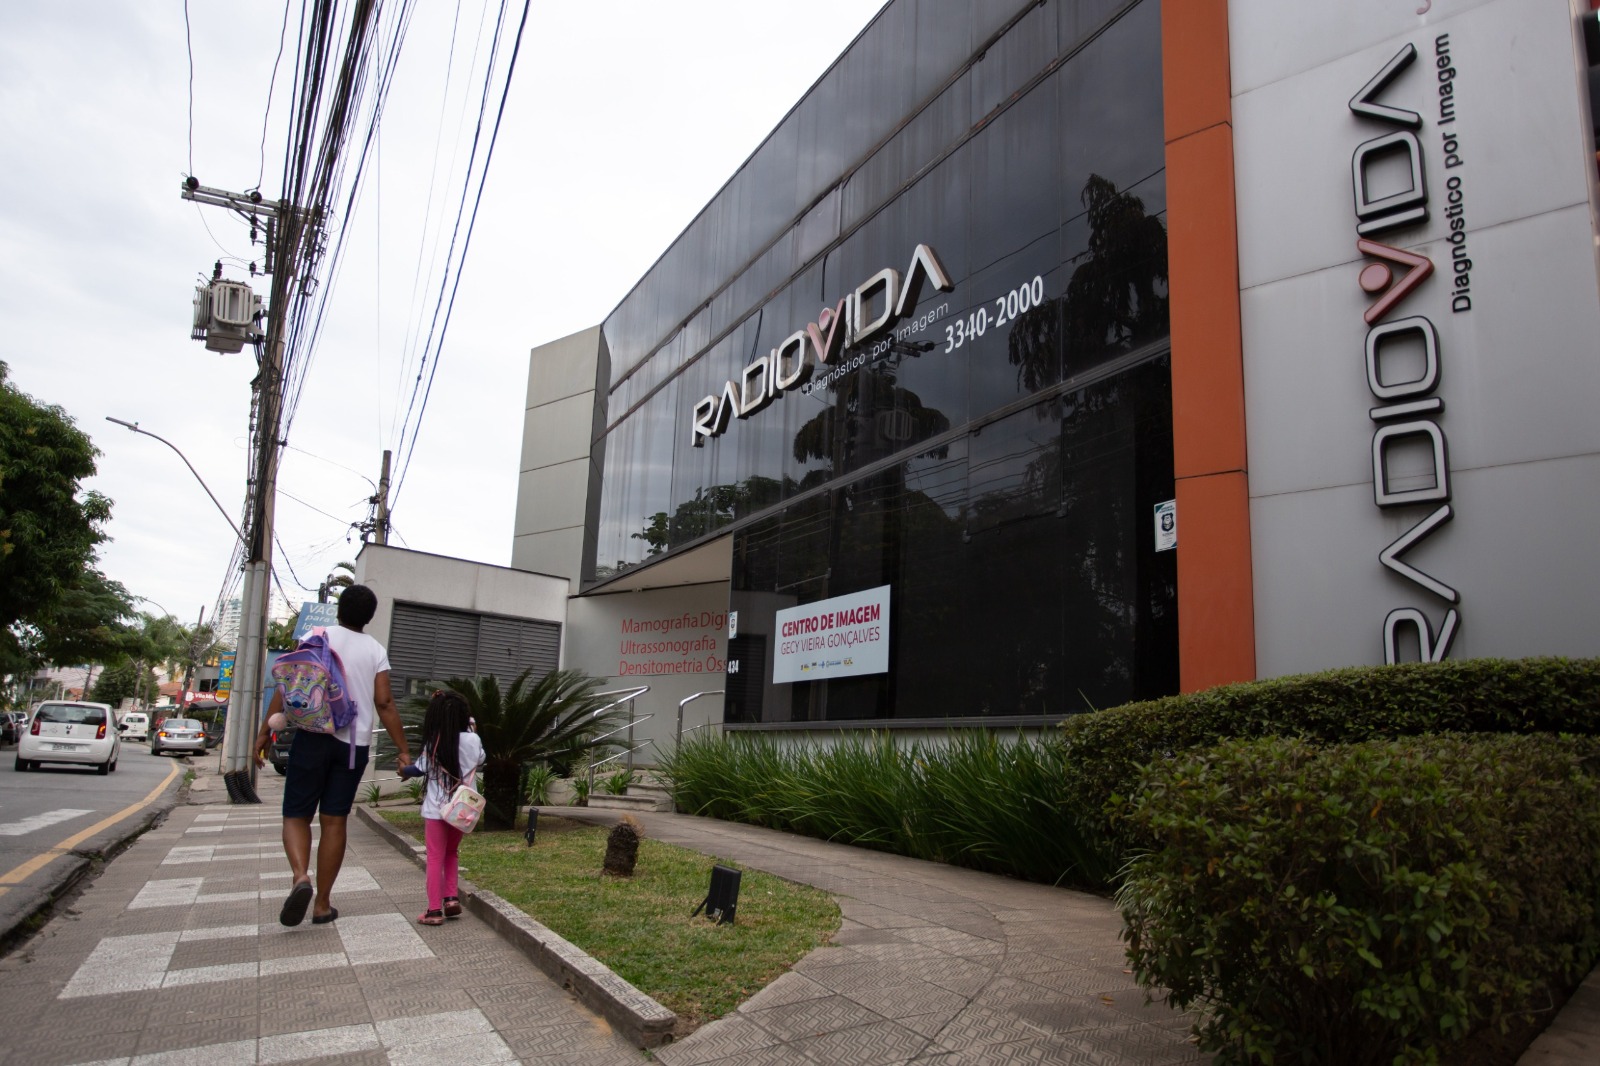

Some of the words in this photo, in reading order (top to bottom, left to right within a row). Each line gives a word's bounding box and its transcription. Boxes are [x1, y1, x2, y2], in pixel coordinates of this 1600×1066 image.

[1434, 33, 1456, 126] Imagem
[1442, 132, 1463, 169] por
[1444, 176, 1472, 314] Diagnóstico
[944, 275, 1044, 354] 3340-2000
[691, 243, 954, 447] RADIOVIDA
[806, 352, 866, 396] Diagnóstico
[872, 336, 892, 360] por
[896, 302, 949, 343] Imagem
[1348, 42, 1461, 665] RADIOVIDA
[620, 635, 716, 656] Ultrassonografia
[621, 612, 698, 634] Mamografia
[781, 640, 800, 655] GECY
[801, 636, 825, 652] VIEIRA
[827, 626, 880, 648] GONÇALVES
[782, 616, 819, 638] CENTRO
[820, 613, 834, 630] DE
[836, 603, 880, 628] IMAGEM
[619, 658, 703, 676] Densitometria
